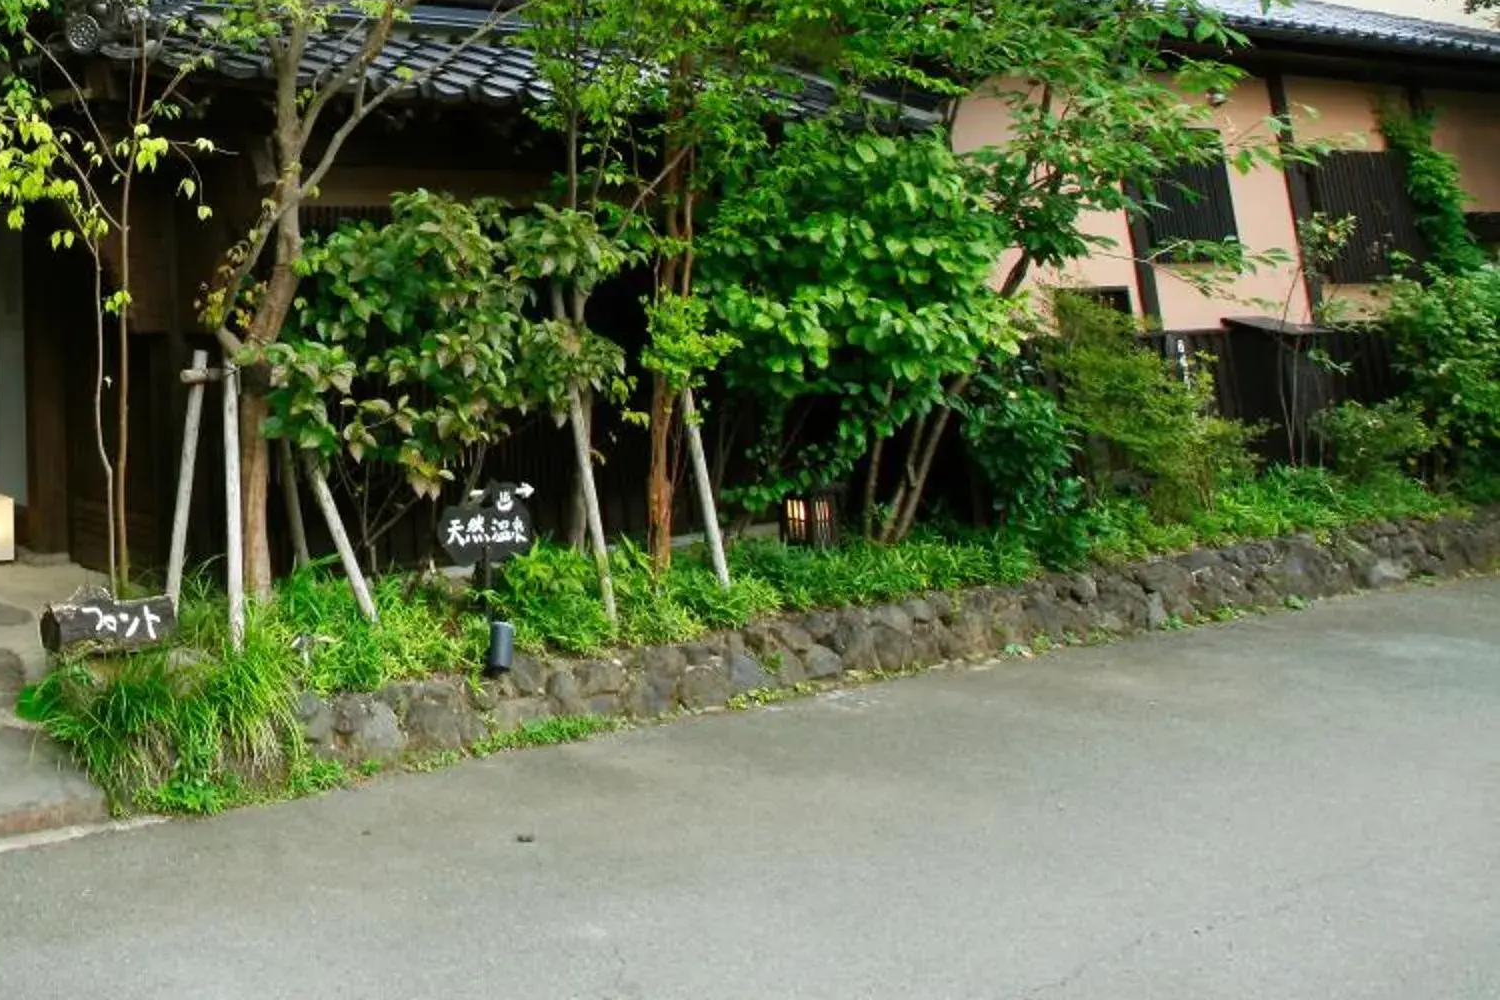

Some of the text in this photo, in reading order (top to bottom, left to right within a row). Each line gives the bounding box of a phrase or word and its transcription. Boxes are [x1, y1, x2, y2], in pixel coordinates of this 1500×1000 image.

[447, 513, 528, 546] 天然温泉
[81, 605, 161, 639] フロント
